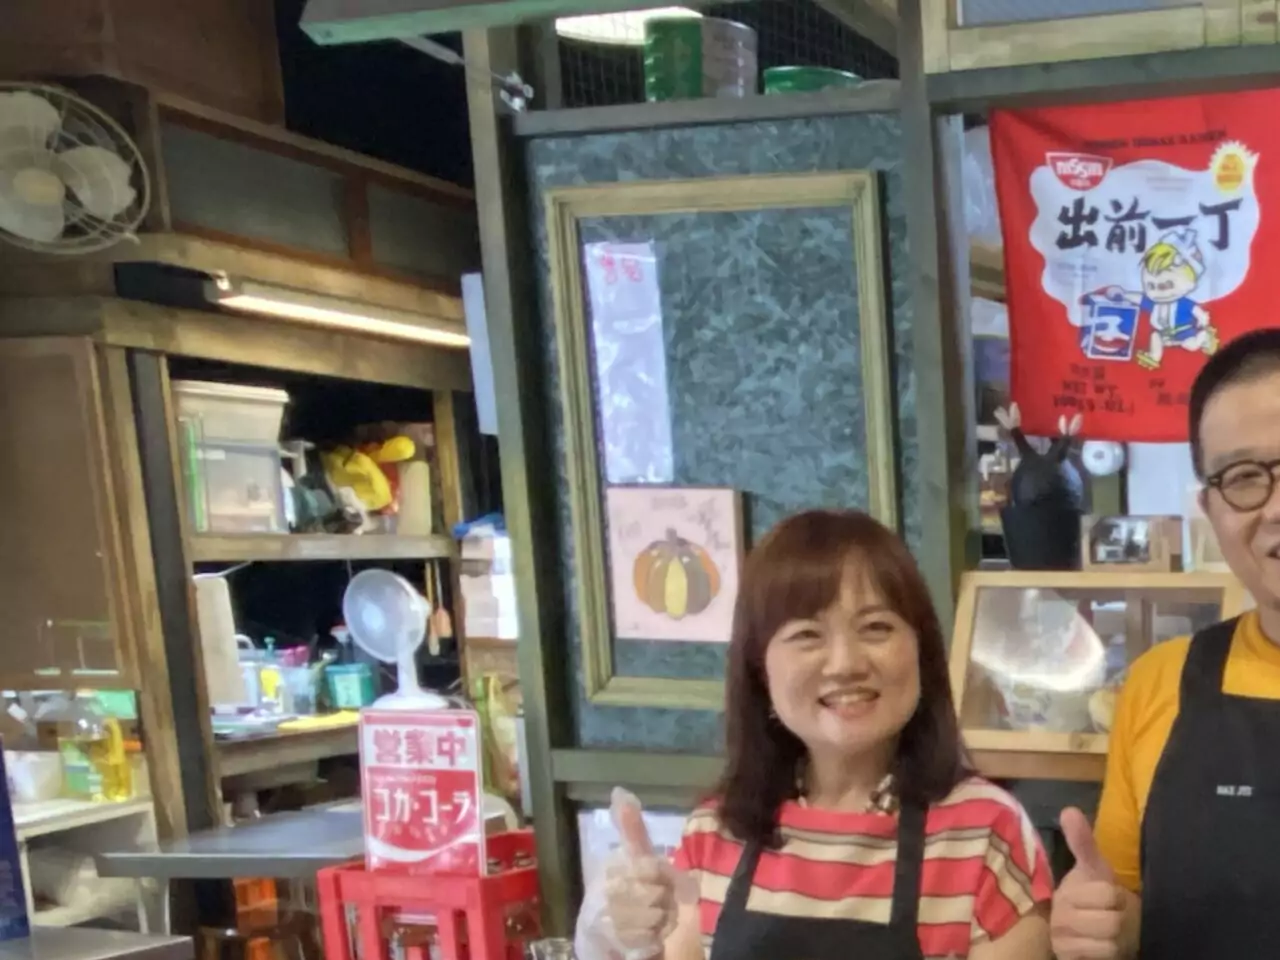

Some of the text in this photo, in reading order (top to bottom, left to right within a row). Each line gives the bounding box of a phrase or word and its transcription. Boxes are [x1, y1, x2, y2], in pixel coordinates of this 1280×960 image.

[1055, 196, 1243, 254] 出前一丁
[373, 788, 471, 825] コカ・コーラ
